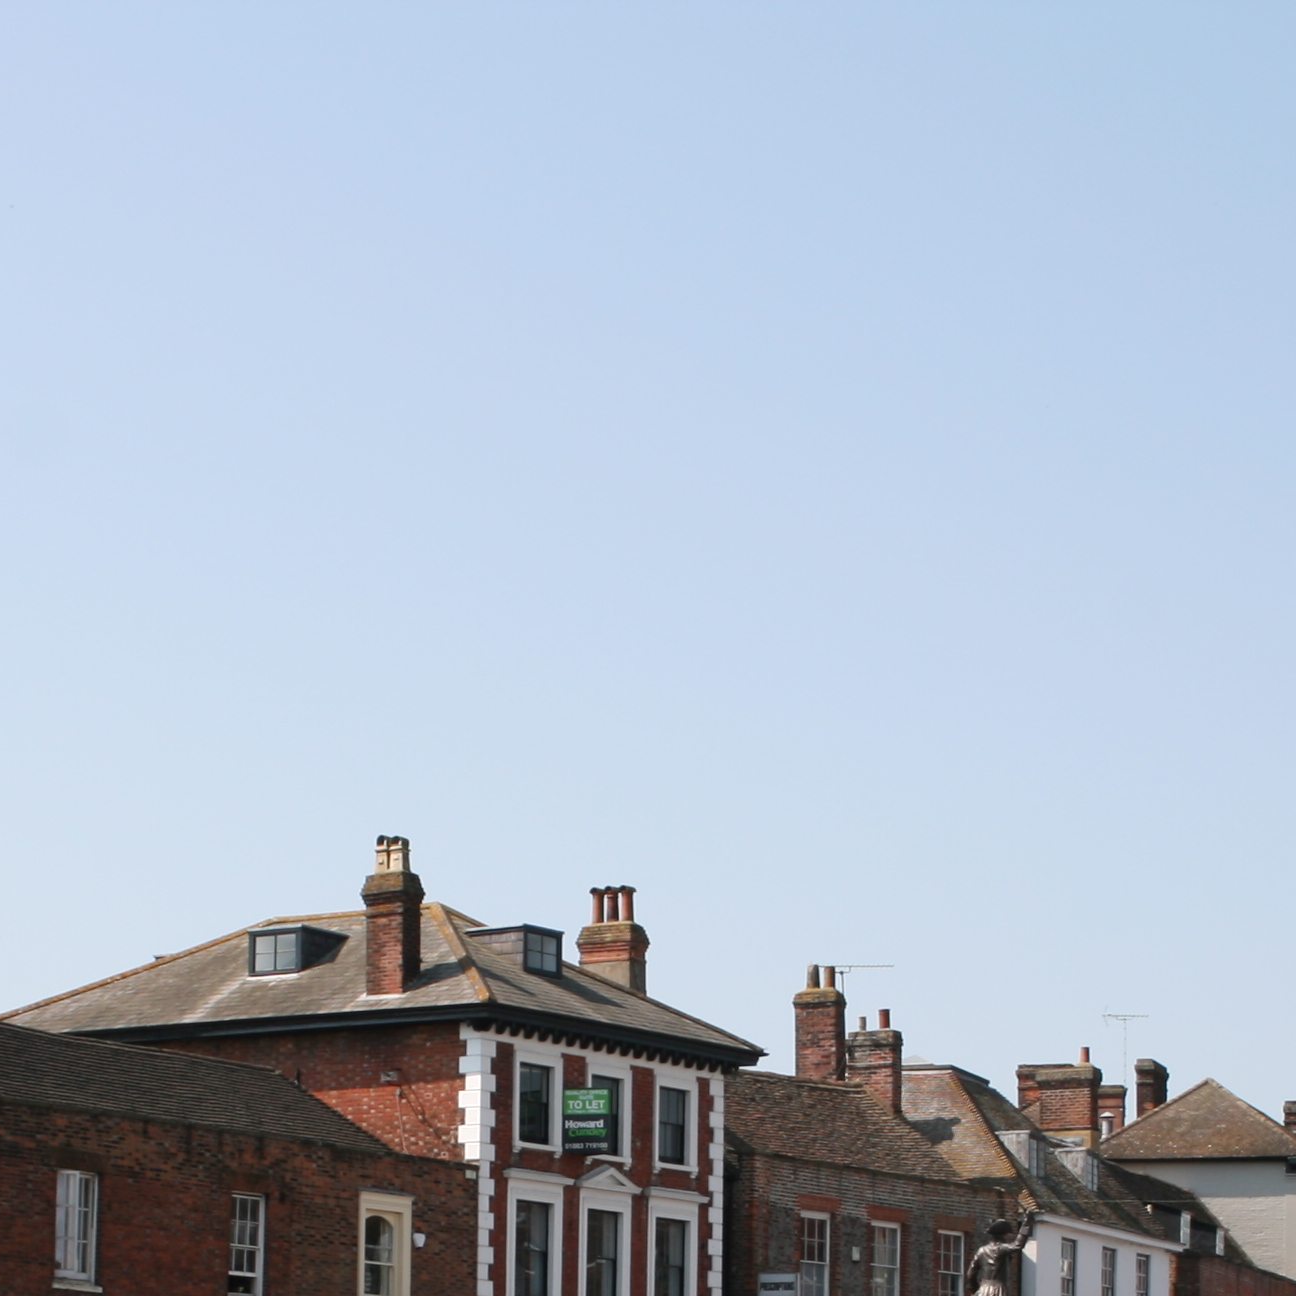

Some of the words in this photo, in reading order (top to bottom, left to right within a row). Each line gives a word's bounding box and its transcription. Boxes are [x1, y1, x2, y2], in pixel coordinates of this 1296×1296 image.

[567, 1100, 583, 1110] TO
[585, 1099, 606, 1109] LET
[564, 1119, 604, 1129] Howard
